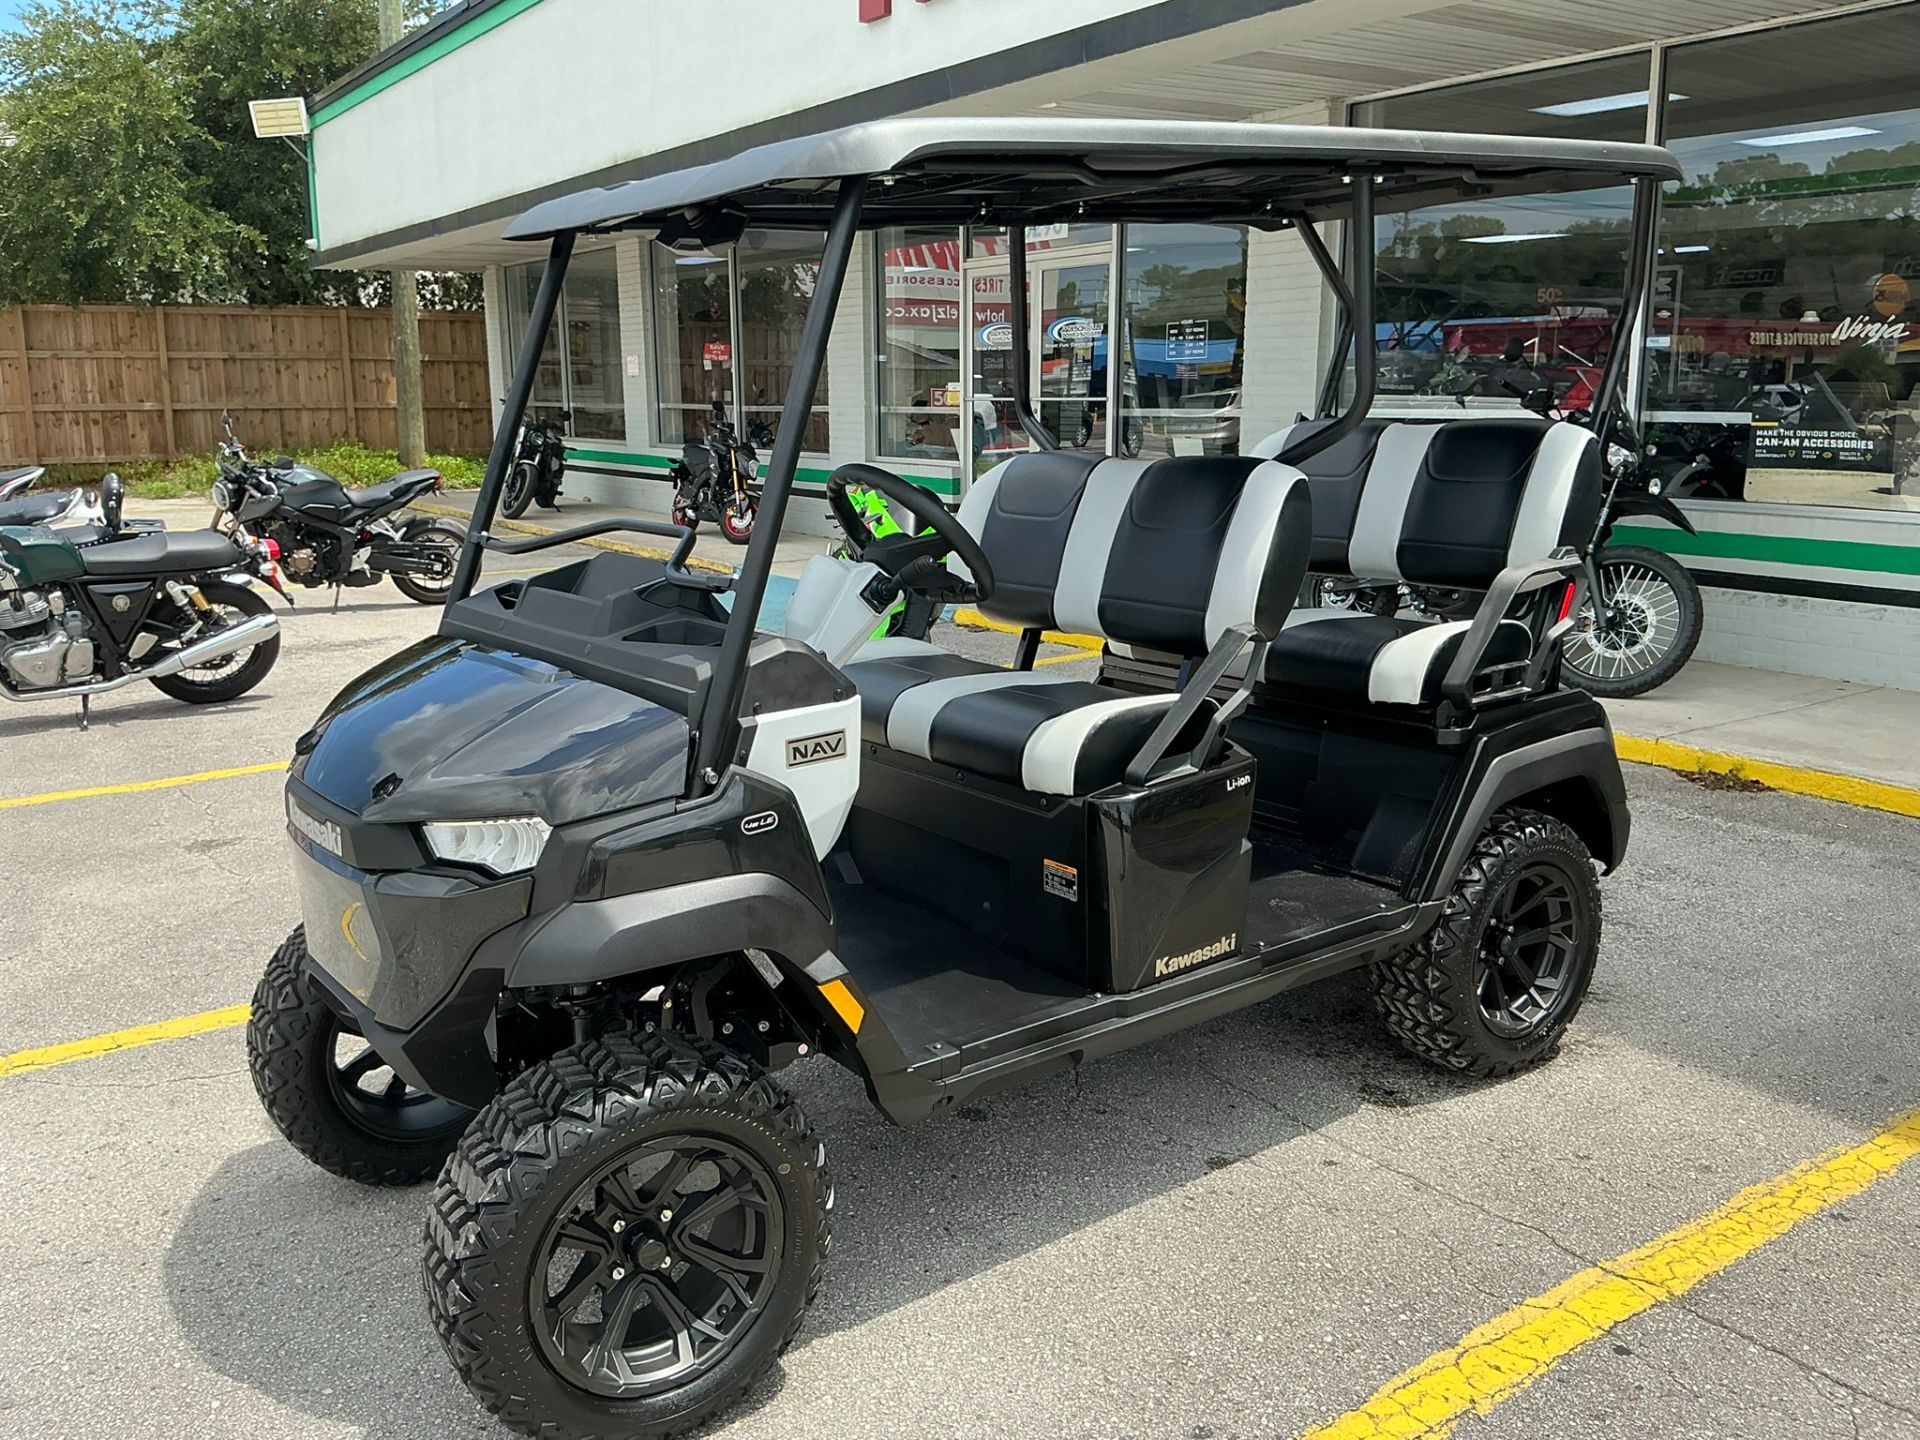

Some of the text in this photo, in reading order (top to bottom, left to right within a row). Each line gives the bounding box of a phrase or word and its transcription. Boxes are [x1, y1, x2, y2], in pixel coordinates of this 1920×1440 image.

[1832, 314, 1910, 347] Ninja
[1756, 438, 1874, 449] CAN-AM ACCESSORIES
[791, 737, 843, 761] NAV
[1226, 774, 1251, 791] Li-ion
[1155, 933, 1236, 978] Kawasaki
